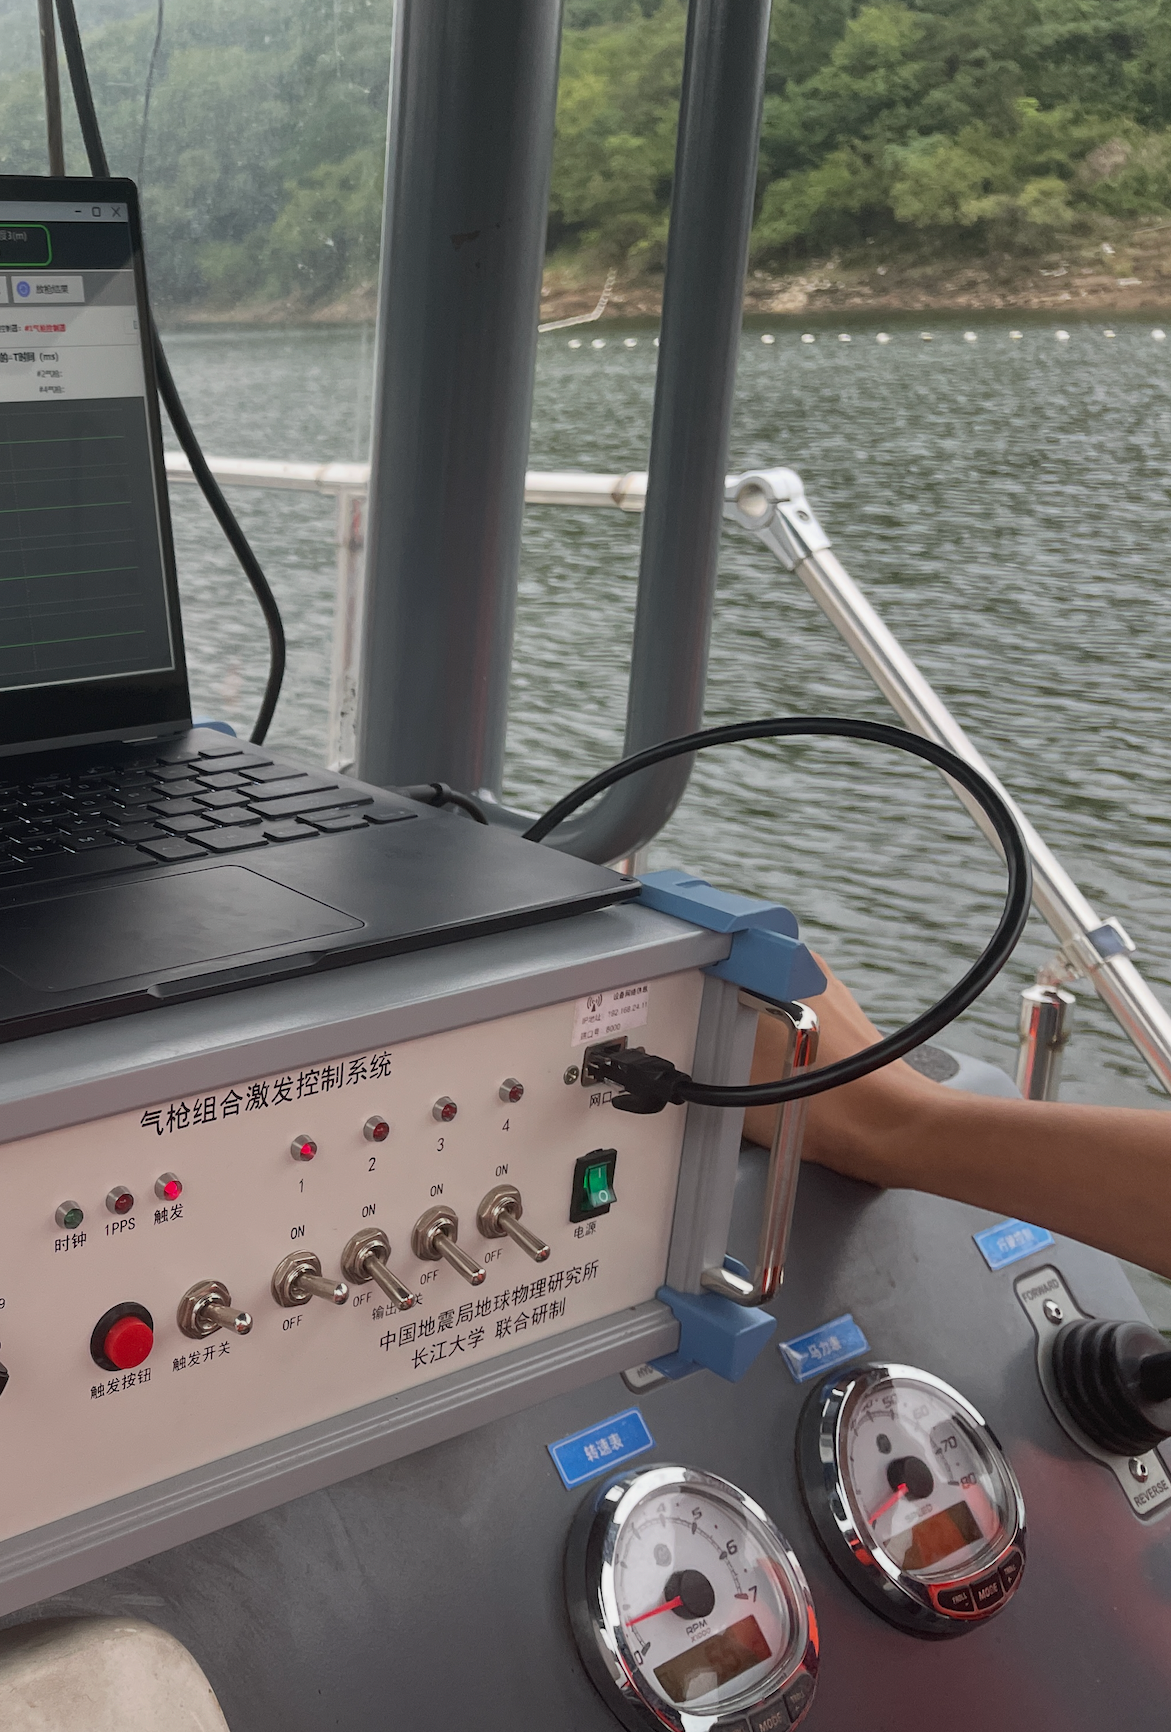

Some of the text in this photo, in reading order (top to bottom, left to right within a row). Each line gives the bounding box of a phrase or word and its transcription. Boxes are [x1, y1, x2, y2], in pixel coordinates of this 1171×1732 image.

[140, 1050, 393, 1136] 气枪组合激发控制系统
[589, 1092, 613, 1109] 网口
[502, 1119, 510, 1133] 4
[437, 1138, 445, 1152] 3
[368, 1158, 376, 1172] 2
[495, 1163, 508, 1177] ON
[299, 1179, 304, 1193] 1
[430, 1183, 444, 1197] ON
[153, 1204, 184, 1225] 触发
[361, 1204, 376, 1218] ON
[104, 1218, 136, 1237] 1PPS
[290, 1225, 305, 1239] ON
[573, 1221, 596, 1239] 电源
[54, 1232, 87, 1253] 时钟
[484, 1249, 503, 1264] OFF
[420, 1269, 439, 1285] OFF
[1021, 1278, 1060, 1303] FORWARD
[352, 1292, 372, 1307] OFF
[371, 1292, 423, 1321] 输出关
[379, 1259, 600, 1352] 中国地震局地球物理研究所
[282, 1314, 303, 1331] OFF
[411, 1300, 566, 1369] 长江大学 联合研制
[172, 1341, 231, 1373] 触发开关
[90, 1368, 152, 1400] 触发按钮
[583, 1432, 624, 1462] 转速表
[941, 1436, 957, 1452] 70
[961, 1473, 977, 1490] 80
[1134, 1479, 1168, 1507] REVERSE
[692, 1507, 702, 1520] 5
[726, 1539, 738, 1556] 6
[748, 1585, 758, 1602] 7
[978, 1584, 999, 1601] MODE
[686, 1619, 708, 1636] RPM
[759, 1714, 783, 1732] MODE
